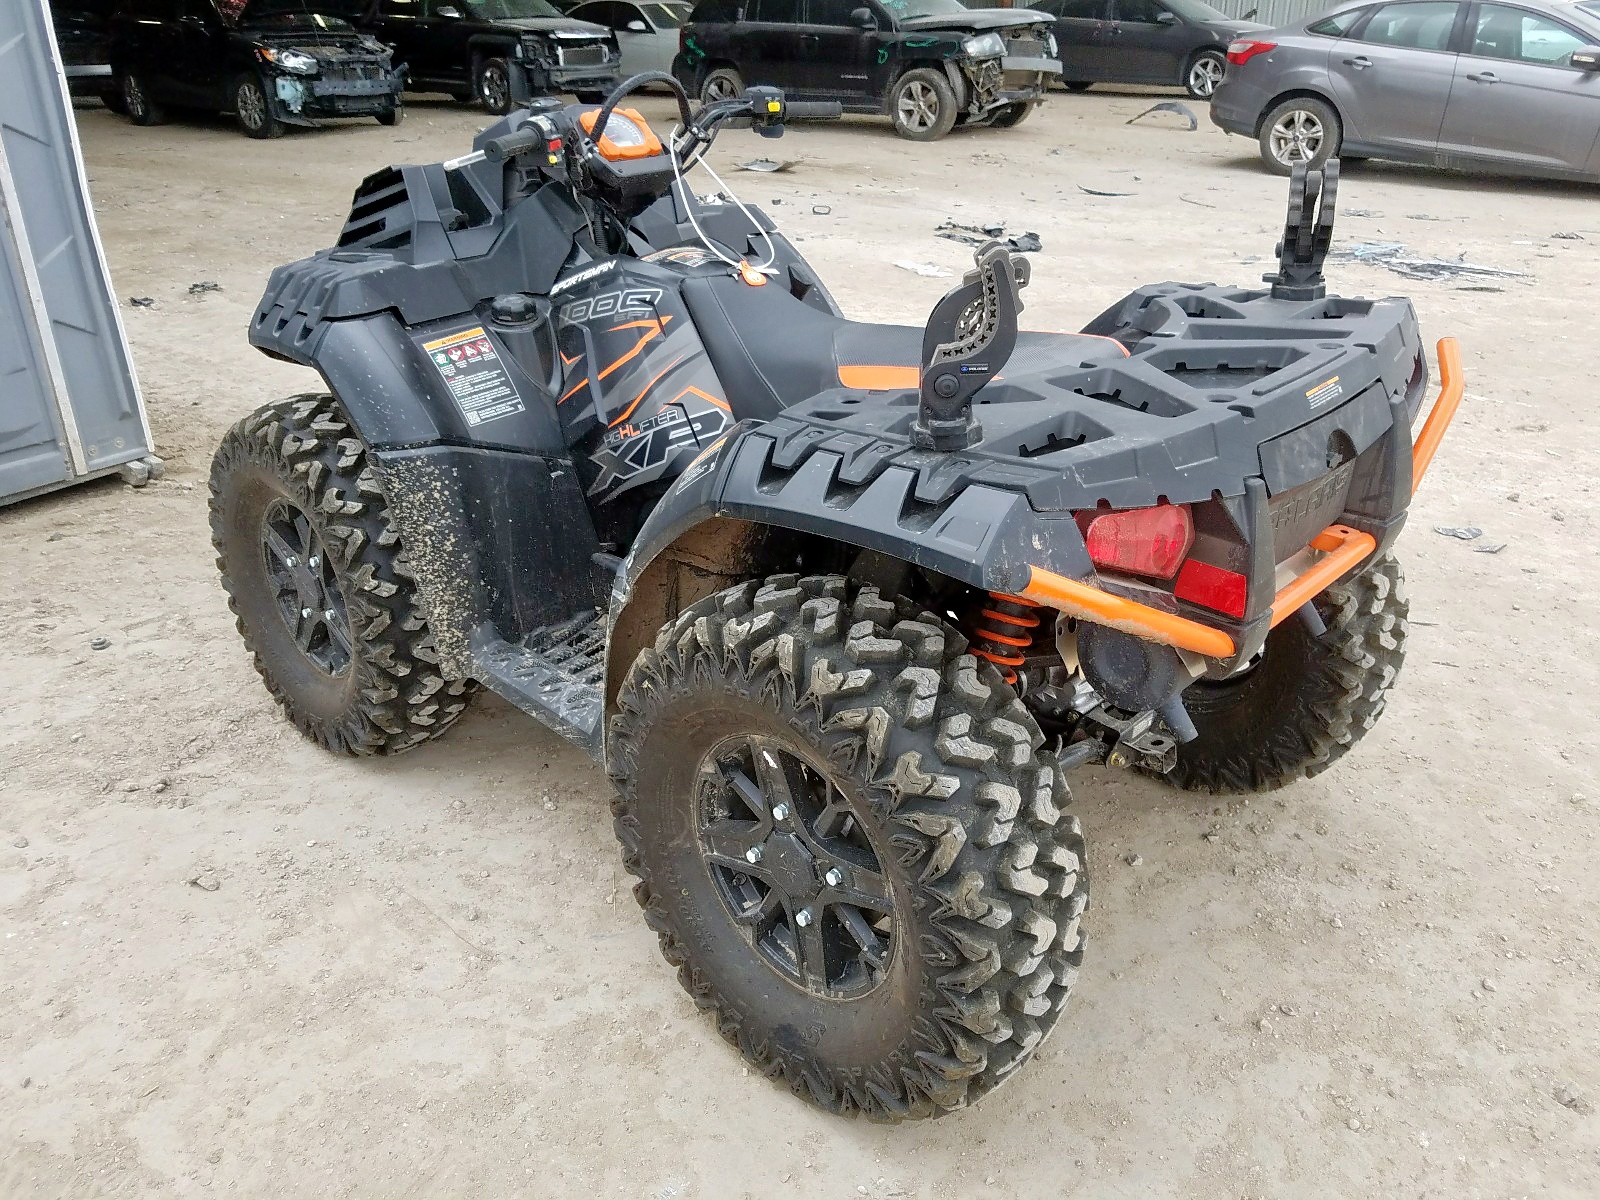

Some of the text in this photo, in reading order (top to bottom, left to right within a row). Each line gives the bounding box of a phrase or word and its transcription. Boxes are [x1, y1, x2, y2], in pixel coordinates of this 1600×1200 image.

[550, 260, 617, 295] SPORTSMAN
[614, 311, 650, 323] EFI
[587, 407, 728, 497] XP
